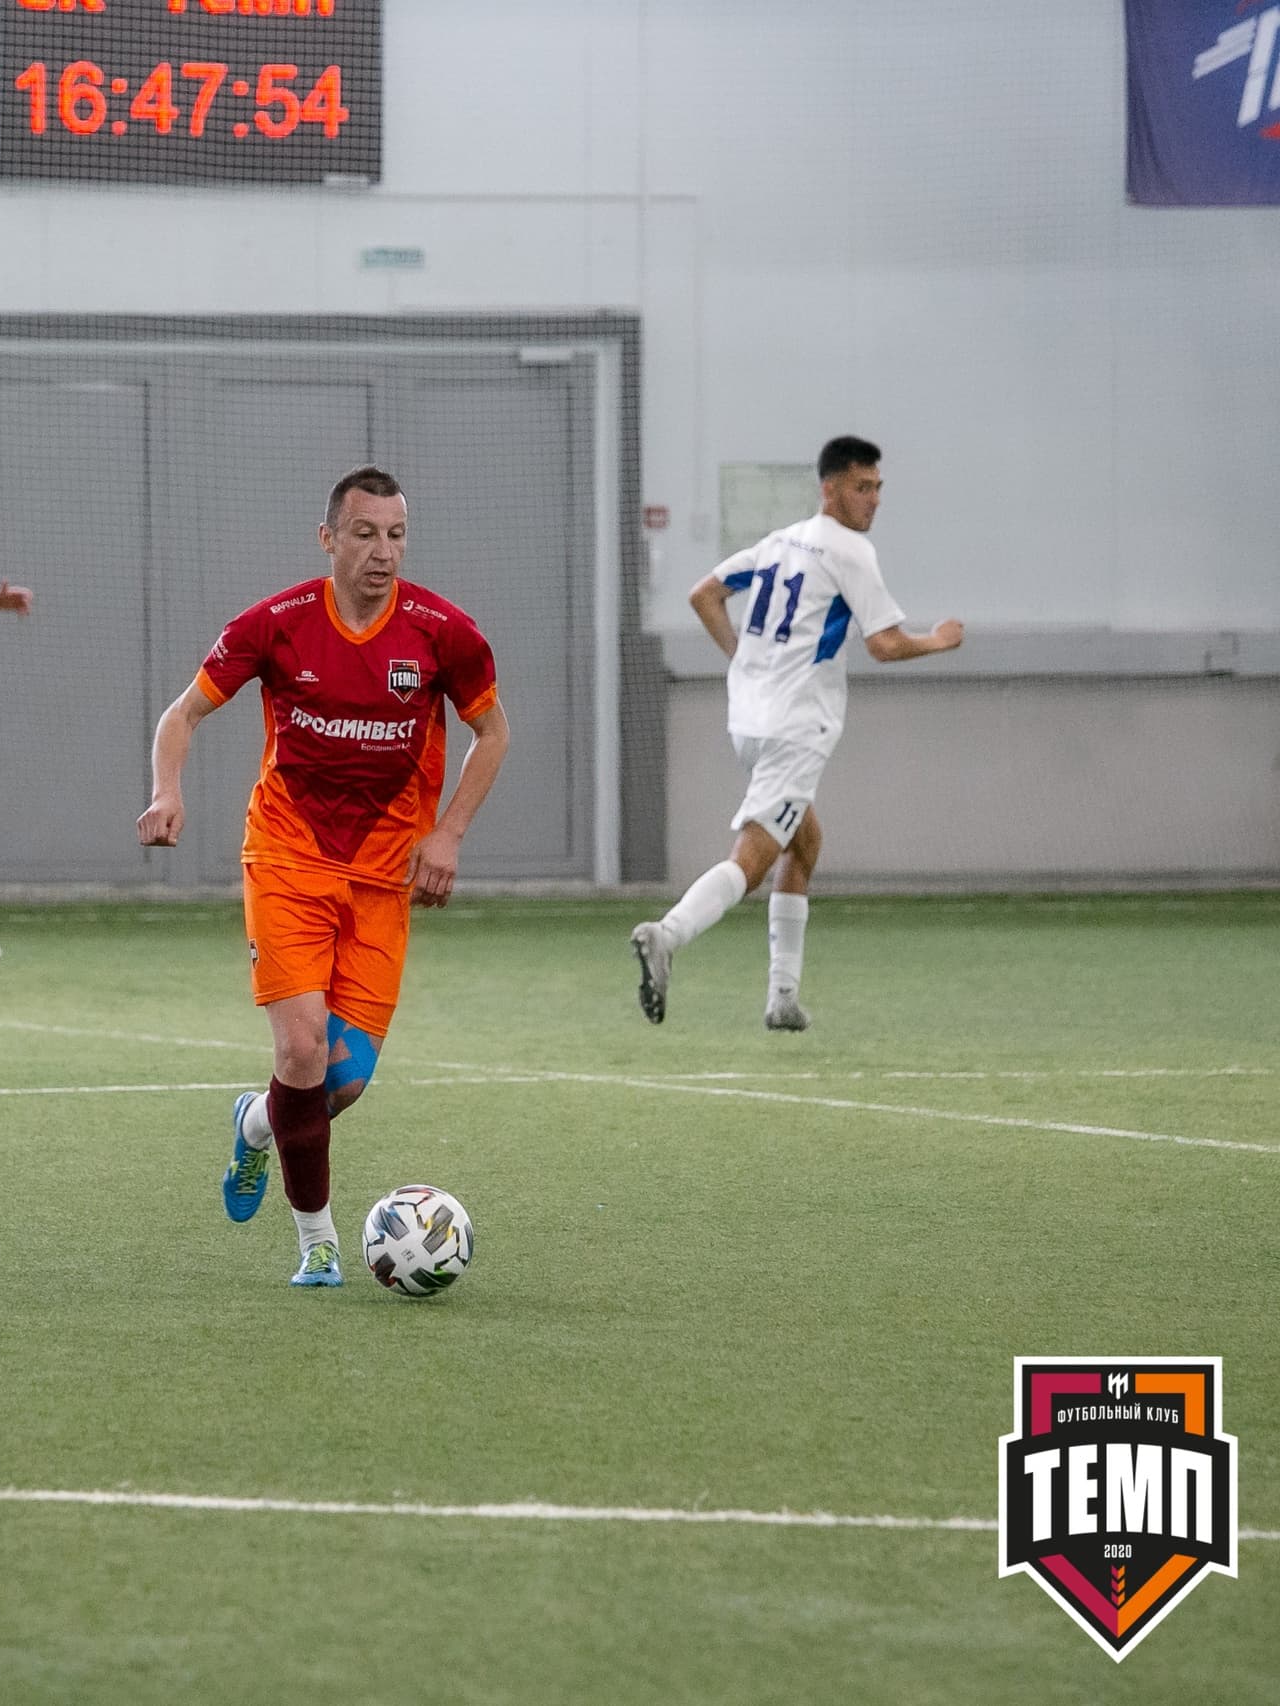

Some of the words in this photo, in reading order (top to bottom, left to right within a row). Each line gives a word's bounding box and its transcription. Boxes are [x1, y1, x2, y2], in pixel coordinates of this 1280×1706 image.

[15, 60, 349, 139] 16:47:54
[746, 562, 805, 644] 11
[391, 671, 418, 688] ТЕМП
[291, 706, 416, 740] ПРОДИНВЕСТ
